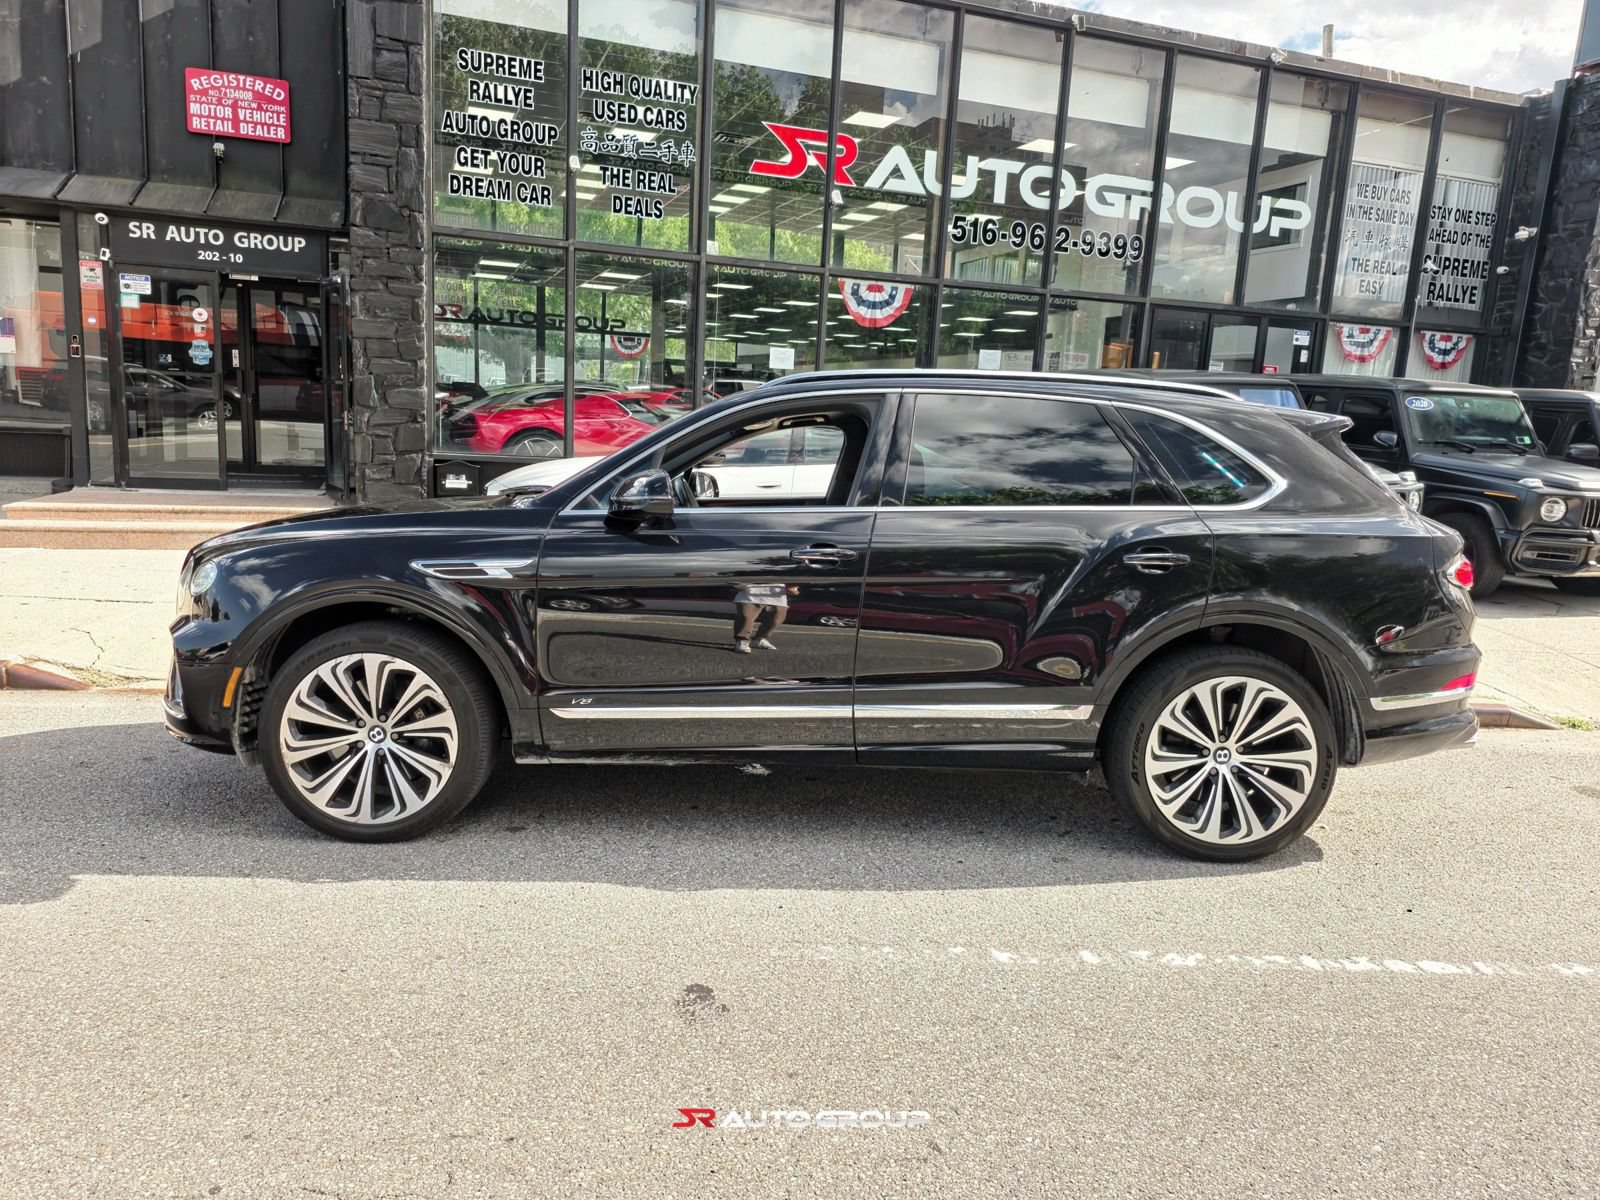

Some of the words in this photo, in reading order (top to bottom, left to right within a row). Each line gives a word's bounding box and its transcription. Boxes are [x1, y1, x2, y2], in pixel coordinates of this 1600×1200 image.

[457, 47, 544, 82] SUPREME
[190, 74, 285, 101] REGISTERED
[469, 79, 534, 110] RALLYE
[581, 68, 624, 95] HIGH
[629, 75, 699, 105] QUALITY
[190, 95, 218, 104] STATE
[238, 100, 258, 109] NEW
[262, 104, 286, 112] YORK
[190, 102, 232, 119] MOTOR
[238, 108, 286, 126] VEHICLE
[594, 98, 638, 124] USED
[643, 106, 686, 132] CARS
[192, 117, 235, 133] RETAIL
[240, 122, 285, 139] DEALER
[441, 110, 491, 137] AUTO
[496, 118, 559, 146] GROUP
[580, 125, 696, 167] 高品質二手車
[456, 146, 491, 169] GET
[496, 151, 545, 178] YOUR
[449, 173, 511, 201] DREAM
[516, 182, 552, 207] CAR
[600, 166, 631, 189] THE
[636, 170, 677, 195] REAL
[749, 120, 859, 188] SR
[863, 145, 1077, 210] AUTO
[1085, 173, 1312, 237] GROUP
[612, 194, 663, 219] DEALS
[1356, 183, 1369, 199] WE
[1371, 184, 1388, 201] BUY
[1390, 187, 1411, 205] CARS
[1346, 203, 1356, 219] IN
[1357, 205, 1373, 221] THE
[1375, 207, 1397, 225] SAME
[1399, 211, 1415, 227] DAY
[1430, 205, 1453, 221] STAY
[1454, 208, 1473, 224] ONE
[1475, 211, 1497, 227] STEP
[128, 221, 156, 240] SR
[165, 225, 224, 245] AUTO
[233, 232, 306, 253] GROUP
[950, 214, 1145, 262] 516-962-9399
[1428, 228, 1458, 244] AHEAD
[1461, 231, 1472, 246] OF
[1475, 233, 1491, 249] THE
[1351, 257, 1370, 273] THE
[1373, 259, 1397, 276] REAL
[1422, 254, 1490, 280] SUPREME
[1359, 279, 1384, 295] EASY
[1426, 281, 1478, 305] RALLYE
[467, 307, 537, 327] AUTO
